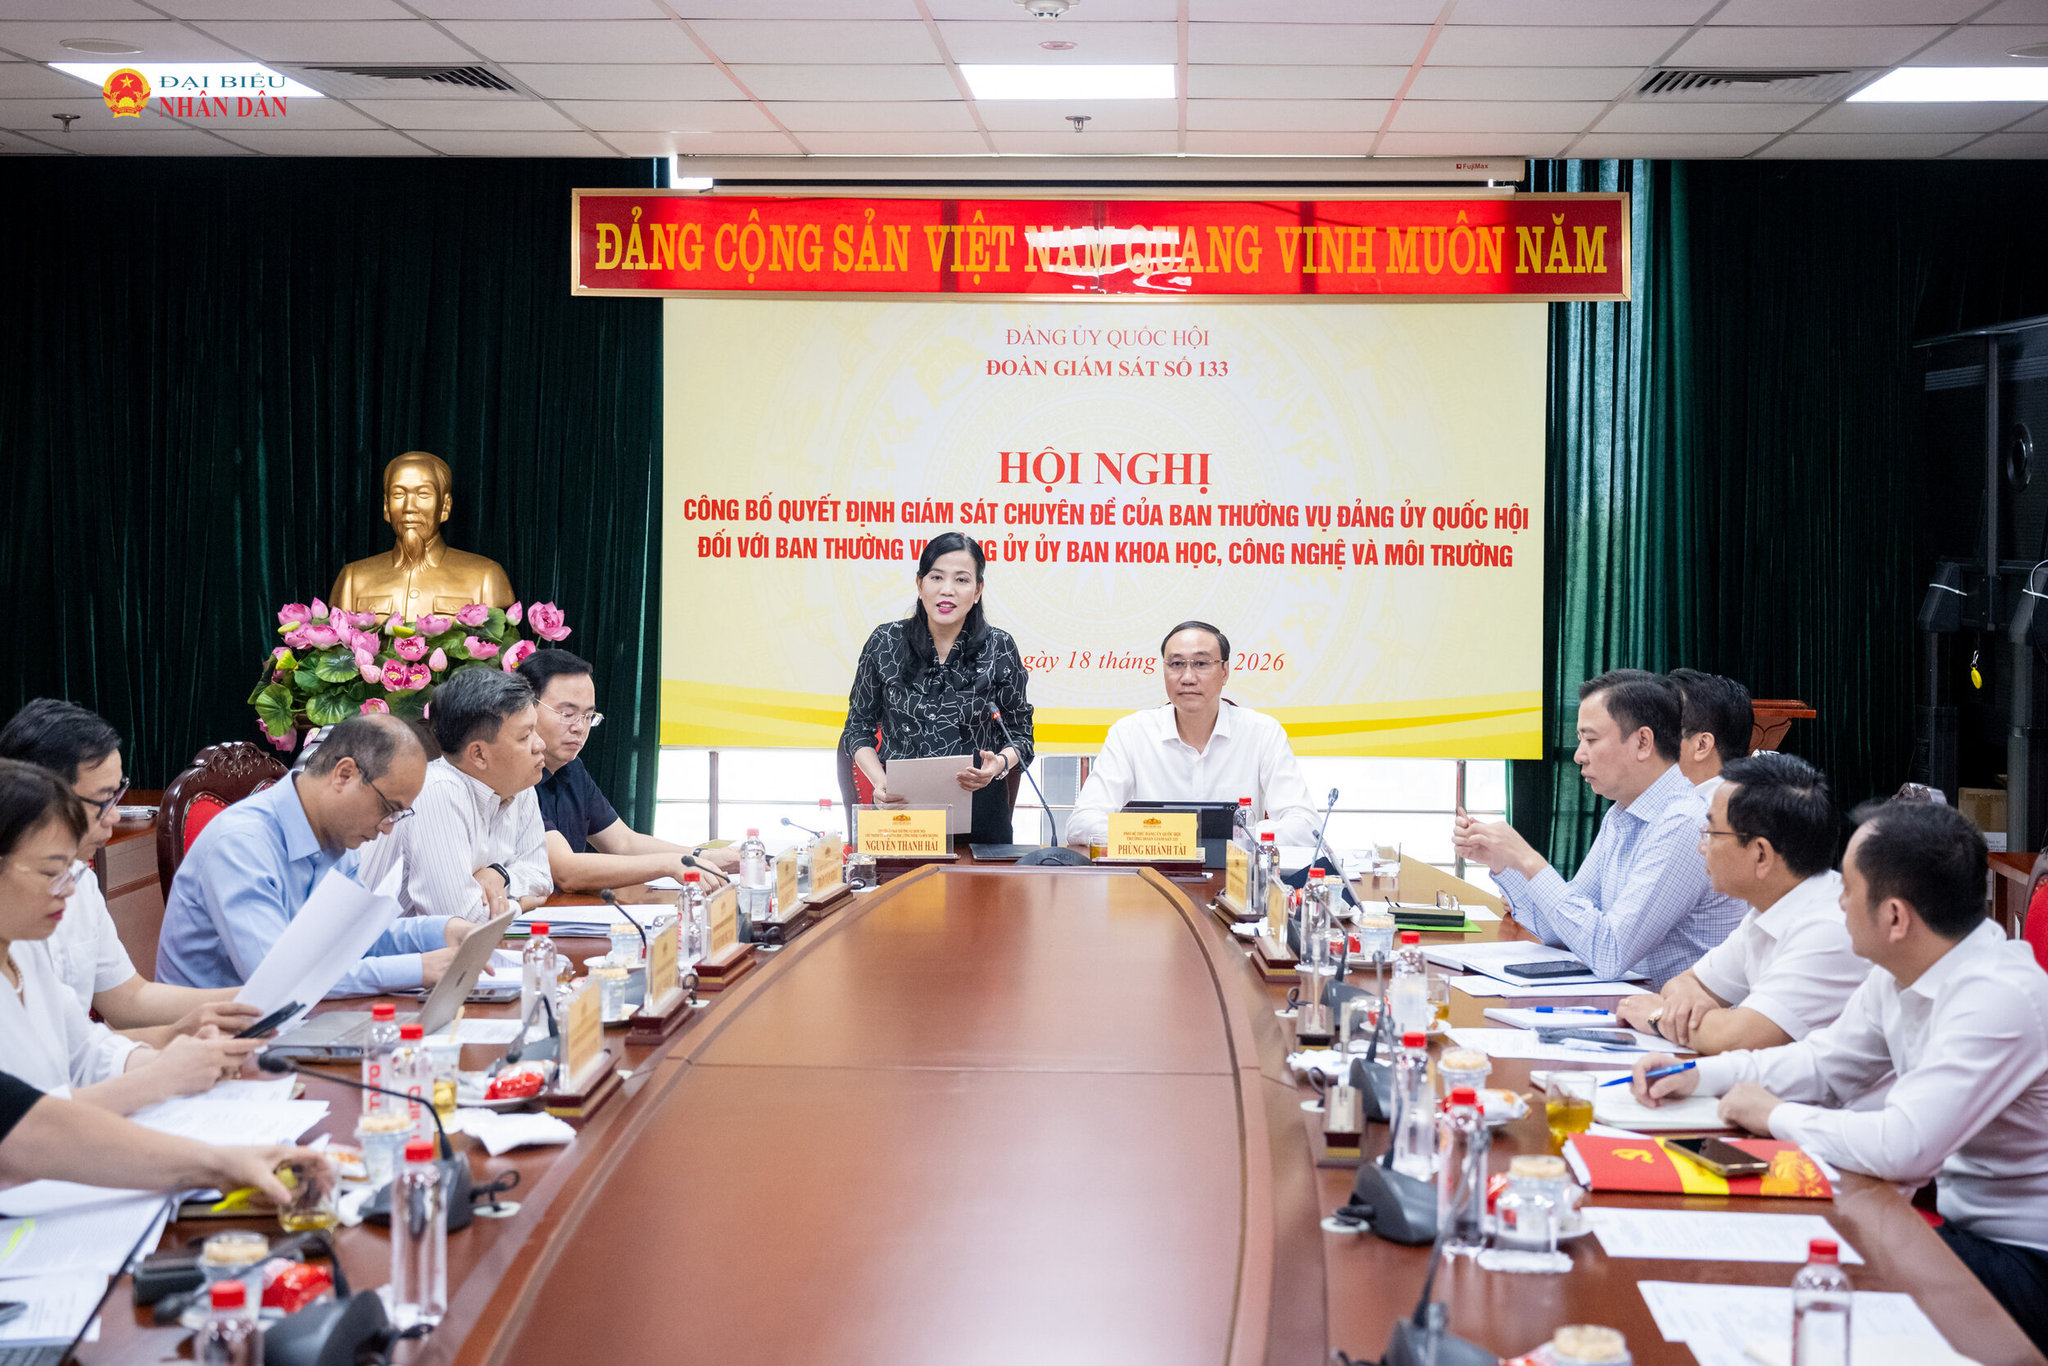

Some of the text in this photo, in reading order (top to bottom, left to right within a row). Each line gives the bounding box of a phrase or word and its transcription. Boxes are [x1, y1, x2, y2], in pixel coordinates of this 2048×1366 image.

[1462, 162, 1489, 171] FujiMax
[595, 206, 1608, 285] ĐẢNG CỘNG SẢN VIỆT NAM QUANG VINH MUÔN NĂM
[1005, 323, 1209, 349] ĐẢNG ỦY QUỐC HỘI
[986, 354, 1229, 377] ĐOÀN GIÁM SÁT SỐ 133
[998, 446, 1212, 495] HỘI NGHỊ
[684, 492, 1529, 534] CÔNG BỐ QUYẾT ĐỊNH GIÁM SÁT CHUYÊN ĐỀ CỦA BAN THƯỜNG VỤ ĐẢNG ỦY QUỐC HỘI
[697, 530, 732, 559] ĐỐI
[737, 531, 769, 559] VỚI
[775, 536, 818, 559] BAN
[823, 533, 904, 561] THƯỜNG
[1003, 532, 1030, 563] ỦY
[1034, 532, 1062, 563] ỦY
[1066, 540, 1110, 564] BAN
[1114, 541, 1170, 564] KHOA
[1175, 541, 1223, 569] HỌC,
[1228, 537, 1285, 565] CÔNG
[1291, 538, 1347, 570] NGHỆ
[1352, 538, 1379, 566] VÀ
[1384, 539, 1425, 567] MÔI
[1430, 542, 1514, 568] TRƯỜNG
[1023, 650, 1286, 675] gày 18 tháng 2026
[865, 838, 896, 851] NGUYỄN
[897, 840, 923, 851] THANH
[1118, 842, 1144, 855] PHÙNG
[1145, 843, 1172, 855] KHÁNH
